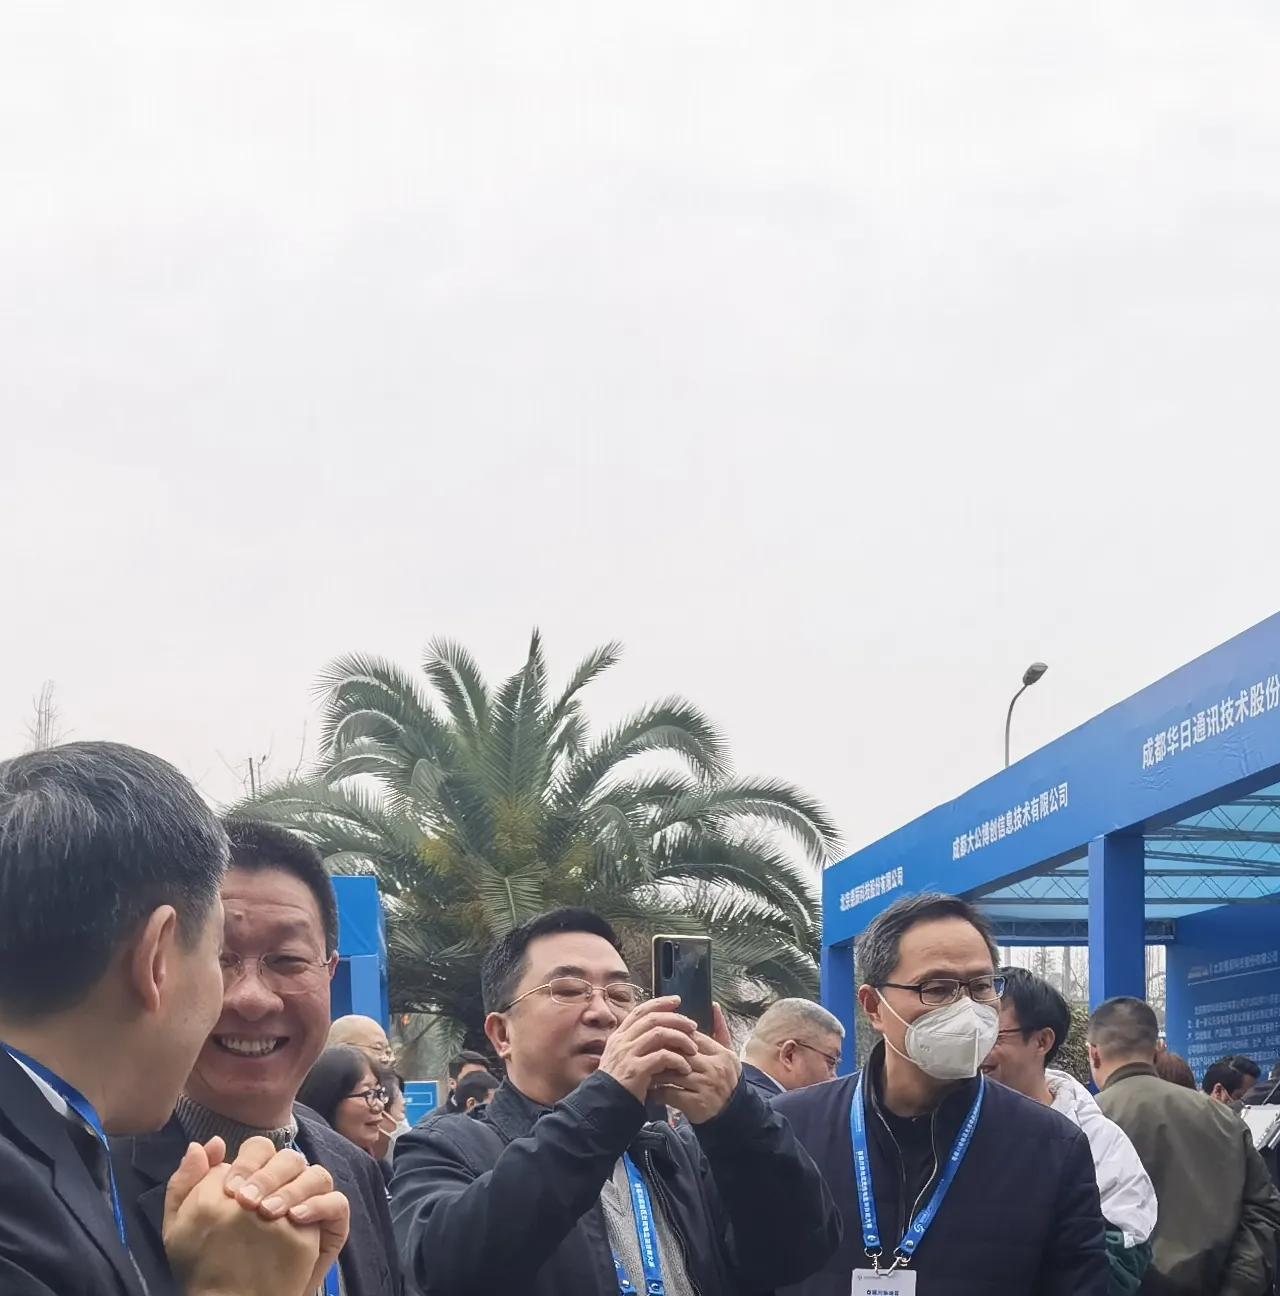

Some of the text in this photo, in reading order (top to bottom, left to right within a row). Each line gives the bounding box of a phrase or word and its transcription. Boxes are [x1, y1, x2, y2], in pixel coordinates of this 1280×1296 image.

[951, 782, 1069, 862] 成都大公博创信息技术有限公司
